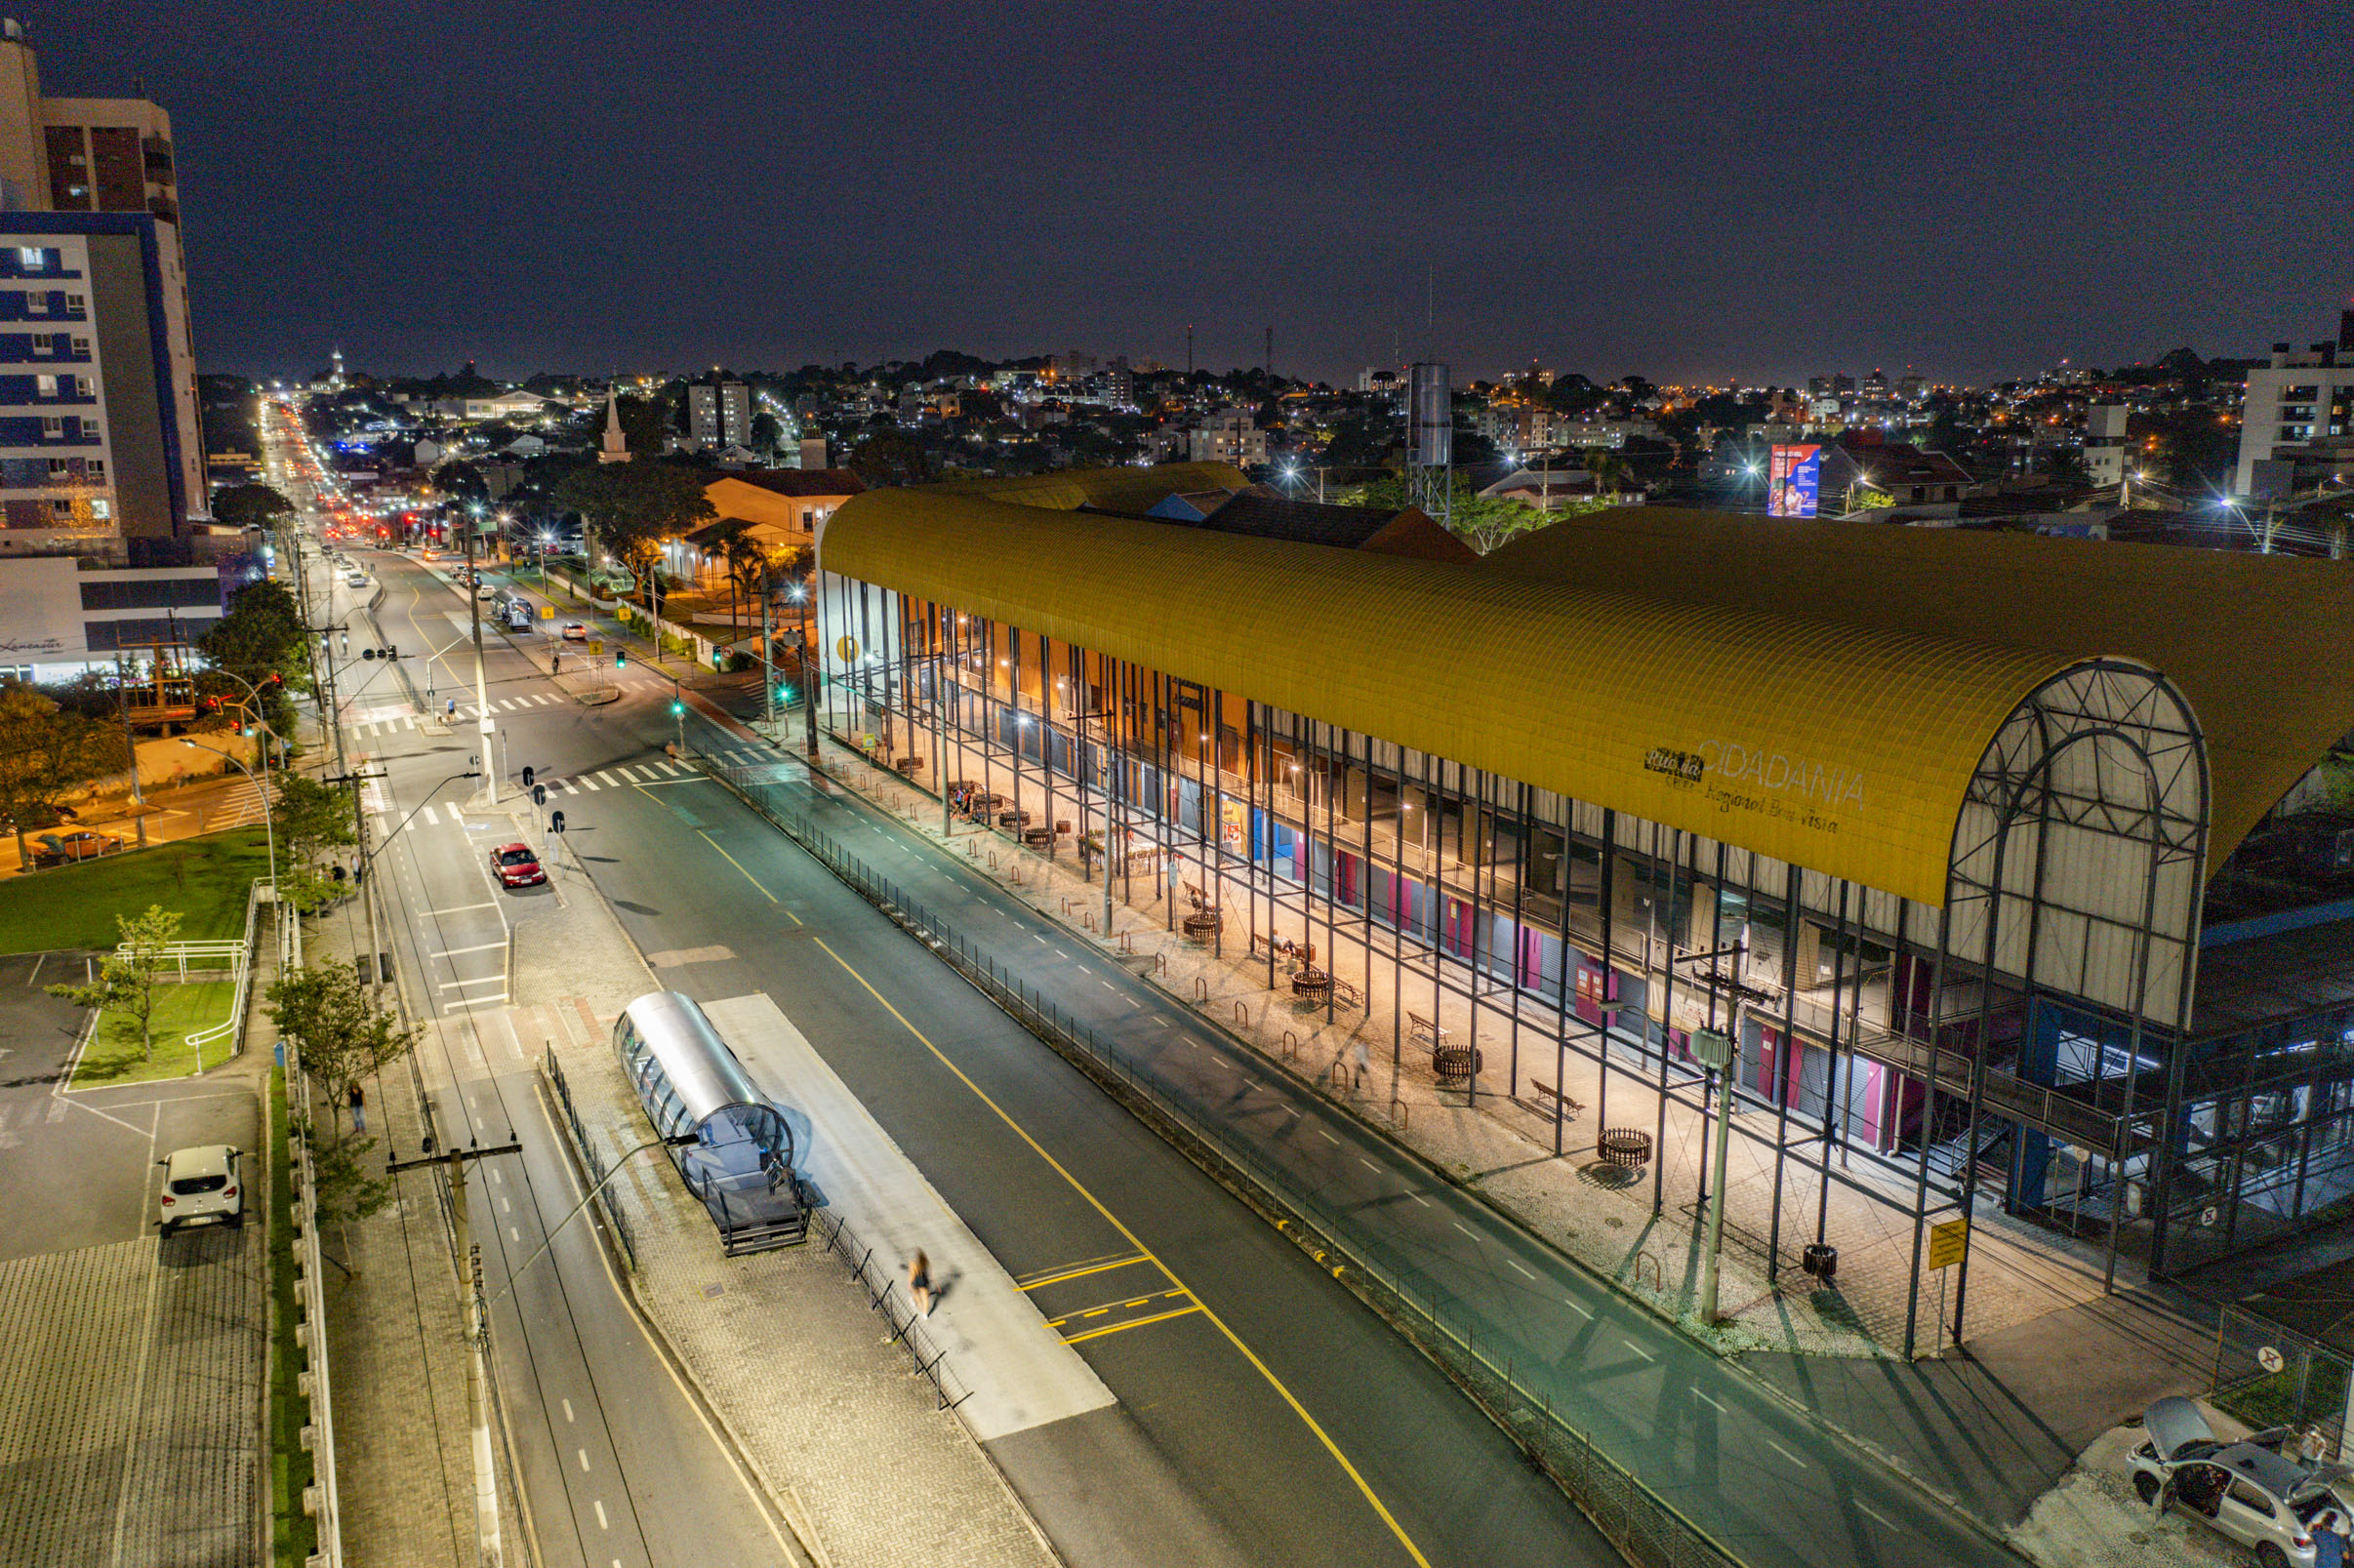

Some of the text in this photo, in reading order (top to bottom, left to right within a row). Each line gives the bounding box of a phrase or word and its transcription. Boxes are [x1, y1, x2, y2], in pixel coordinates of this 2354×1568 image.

[1680, 757, 1699, 776] da
[1696, 740, 1864, 811] CIDADANIA
[1704, 781, 1766, 813] Regional
